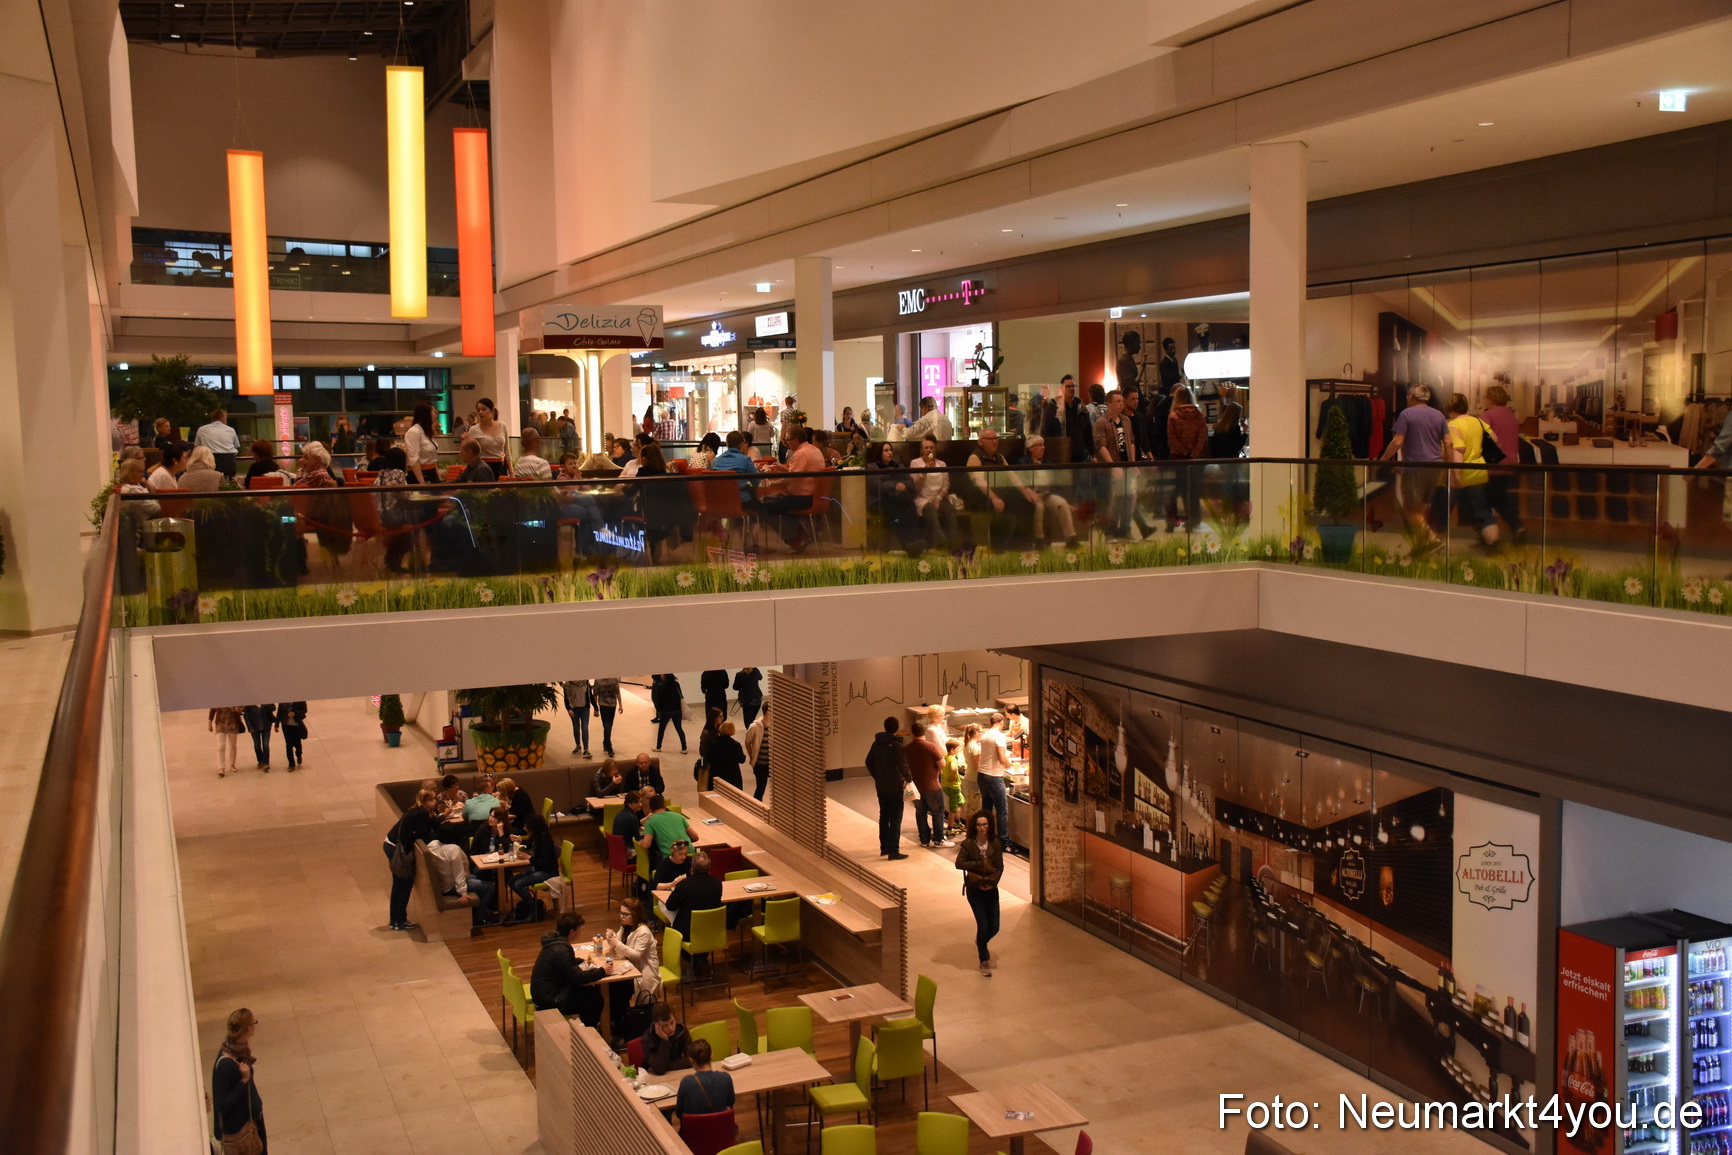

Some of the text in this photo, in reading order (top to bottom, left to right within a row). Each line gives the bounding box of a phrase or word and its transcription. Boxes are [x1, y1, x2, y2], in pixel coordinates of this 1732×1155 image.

[898, 288, 925, 315] EMC
[546, 313, 631, 331] Delizia
[924, 364, 940, 386] T
[1462, 868, 1524, 884] ALTOBELLI
[1560, 967, 1611, 993] Jetzt eiskalt
[1563, 979, 1607, 1001] erfrischen!
